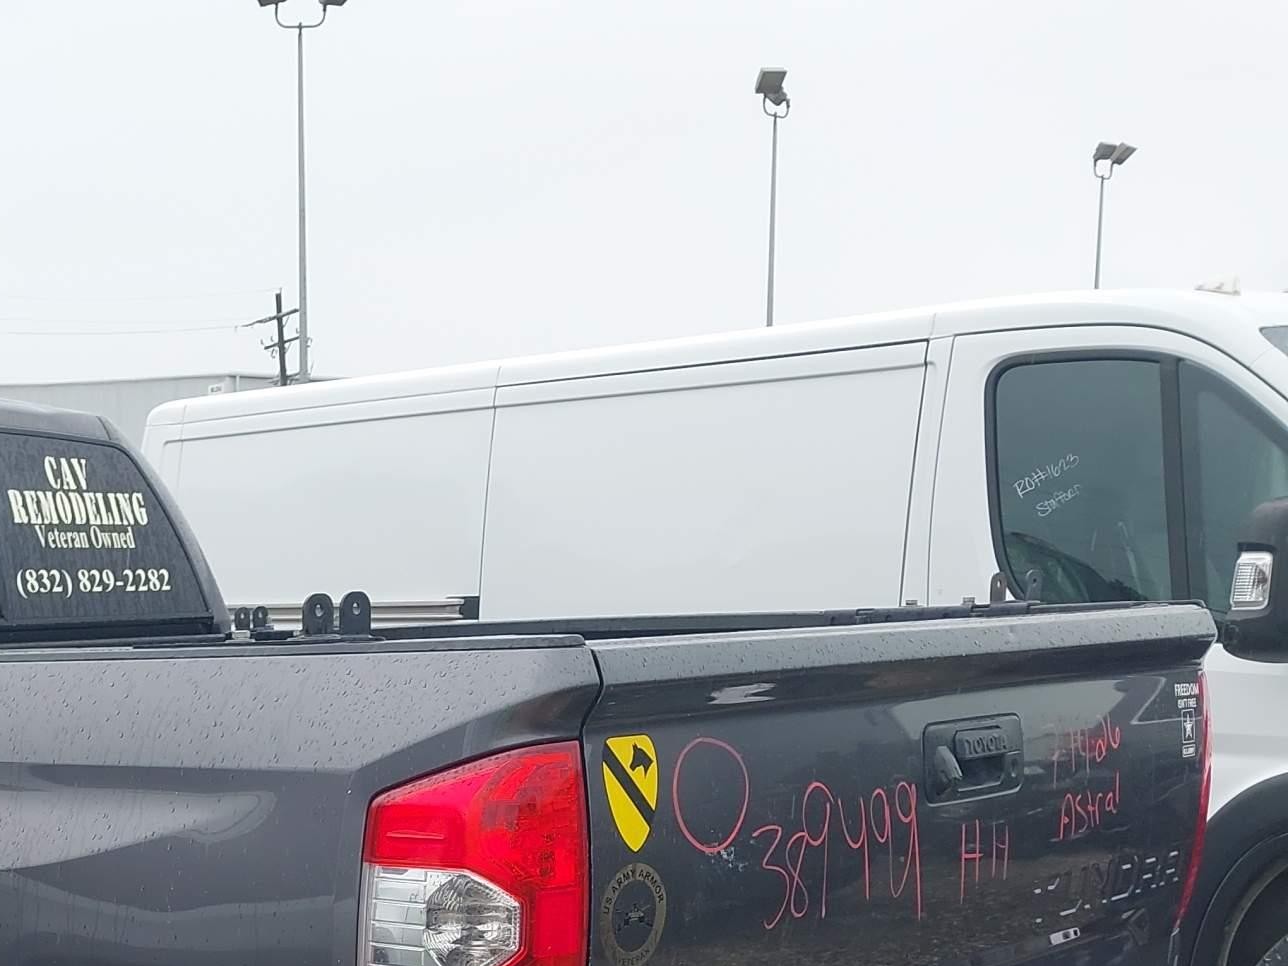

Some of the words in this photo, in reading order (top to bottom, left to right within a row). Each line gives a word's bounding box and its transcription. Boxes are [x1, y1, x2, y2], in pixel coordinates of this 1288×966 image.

[44, 455, 87, 490] CAV
[7, 488, 149, 526] REMODELING
[34, 524, 89, 549] Veteran
[90, 525, 136, 549] Owned
[16, 568, 73, 599] (832)
[77, 568, 171, 593] 829-2282
[1174, 682, 1200, 697] FREEDOM
[964, 733, 1008, 756] TOYOTA
[612, 869, 636, 896] ARMY
[638, 869, 665, 904] ARMOR
